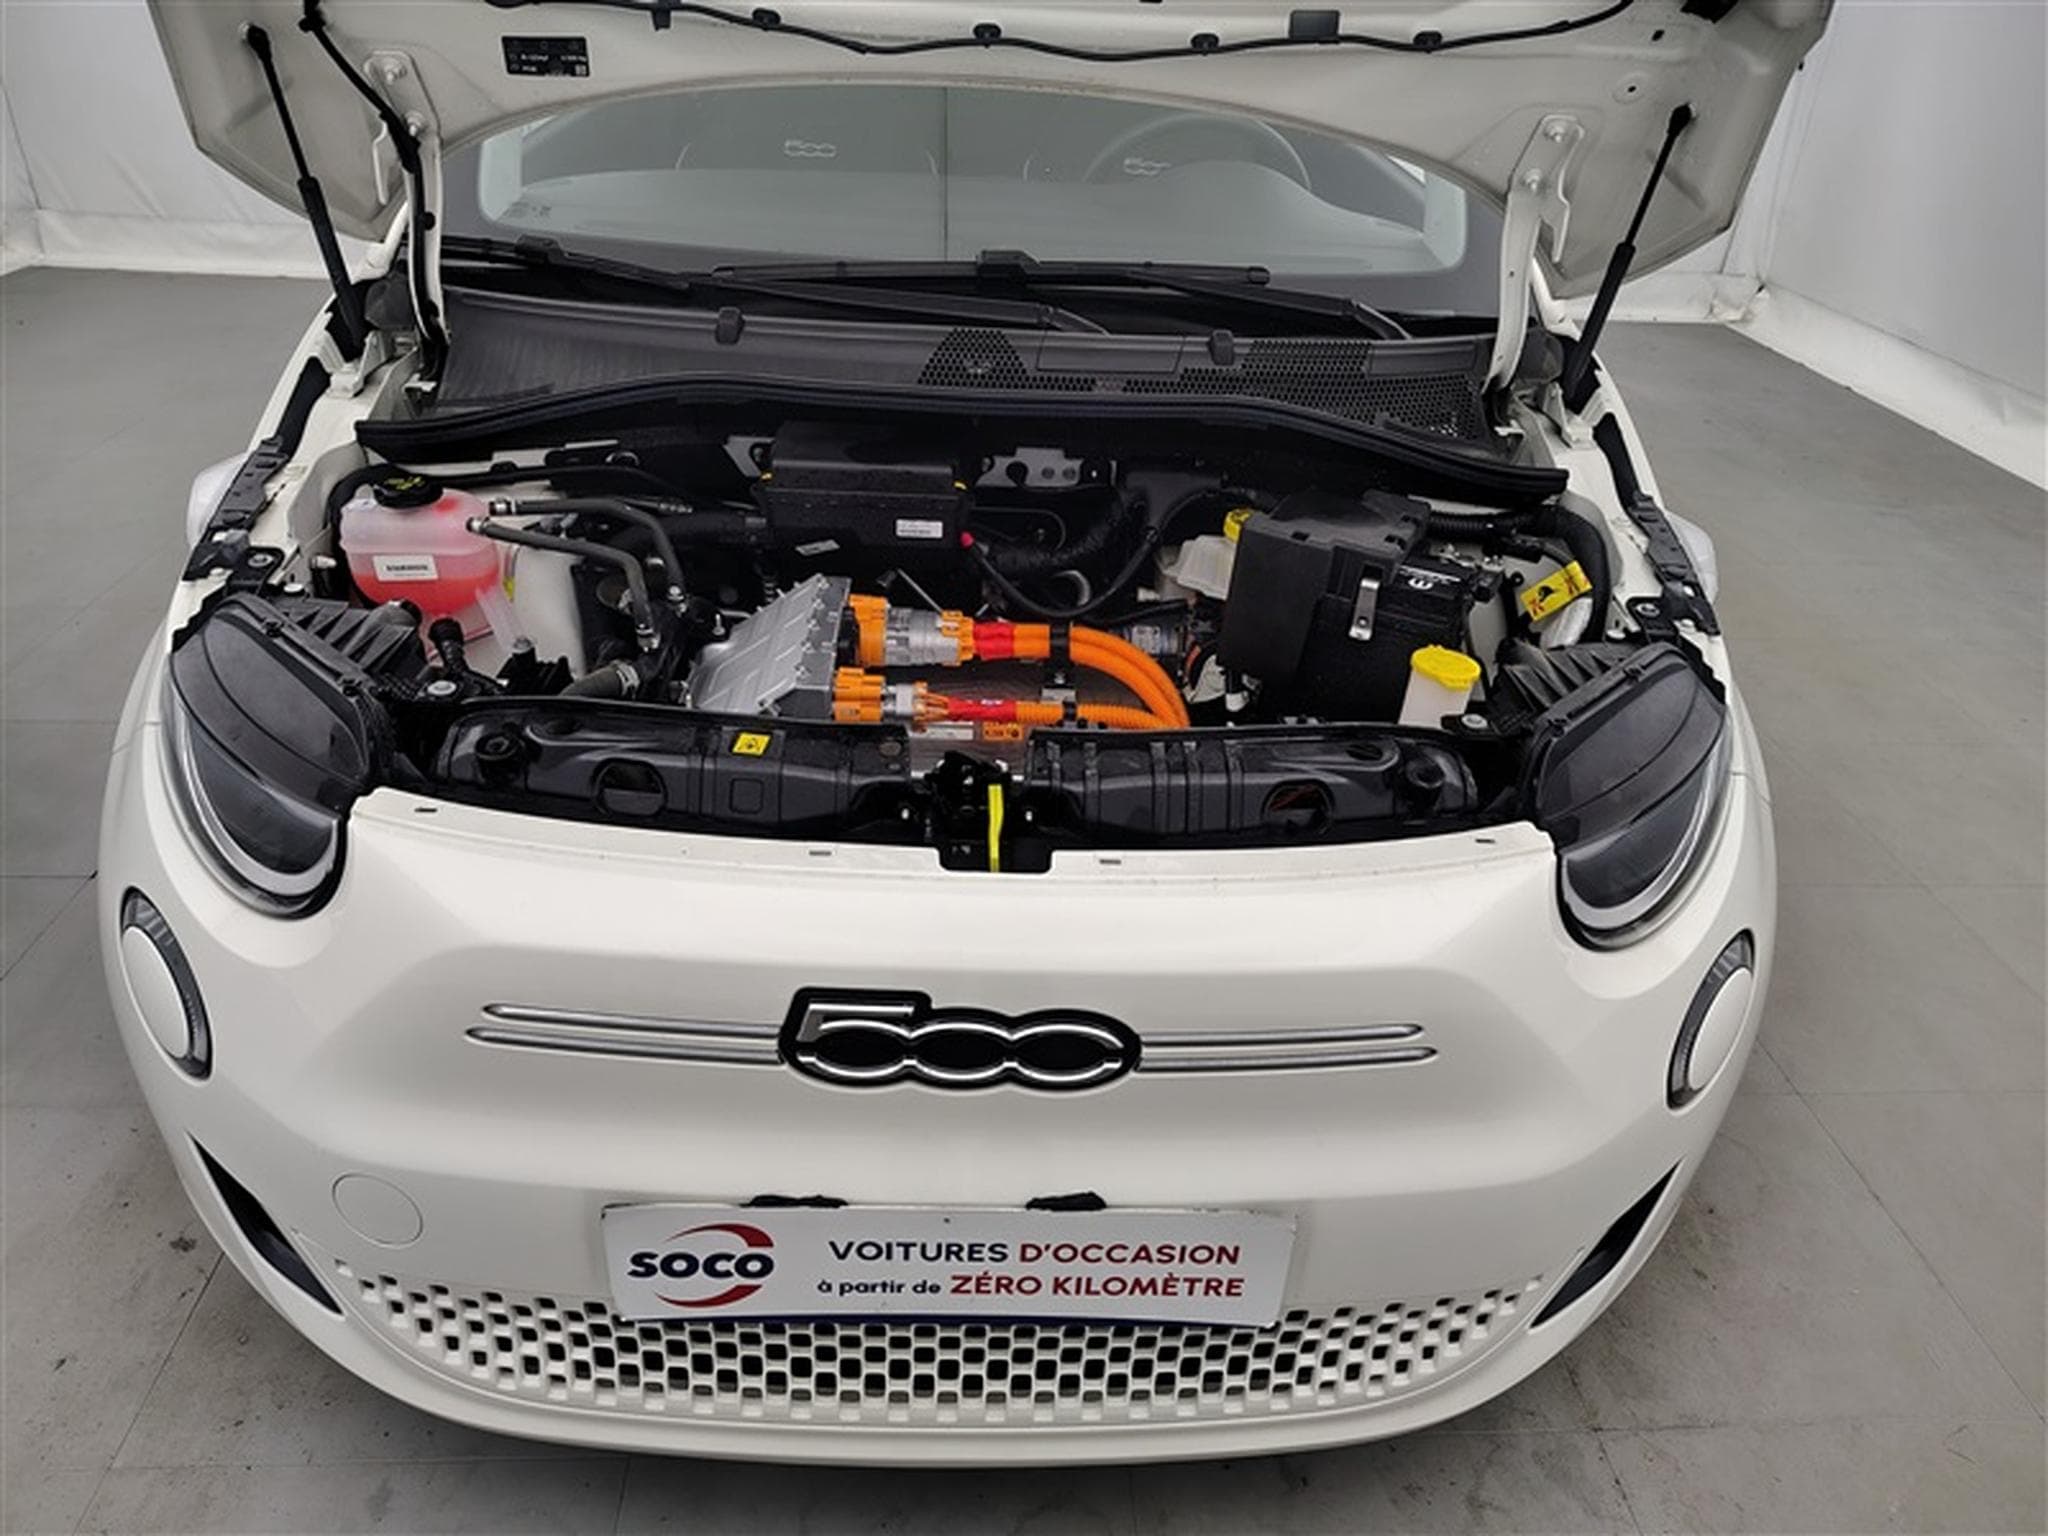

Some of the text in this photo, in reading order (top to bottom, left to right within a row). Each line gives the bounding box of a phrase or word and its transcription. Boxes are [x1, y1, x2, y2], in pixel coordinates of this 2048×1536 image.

[791, 998, 1130, 1086] 500
[626, 1251, 775, 1279] SOCO
[828, 1240, 1241, 1265] VOITURES D'OCCASION
[816, 1270, 1245, 1297] à partir de ZÉRO KILOMÈTRE
